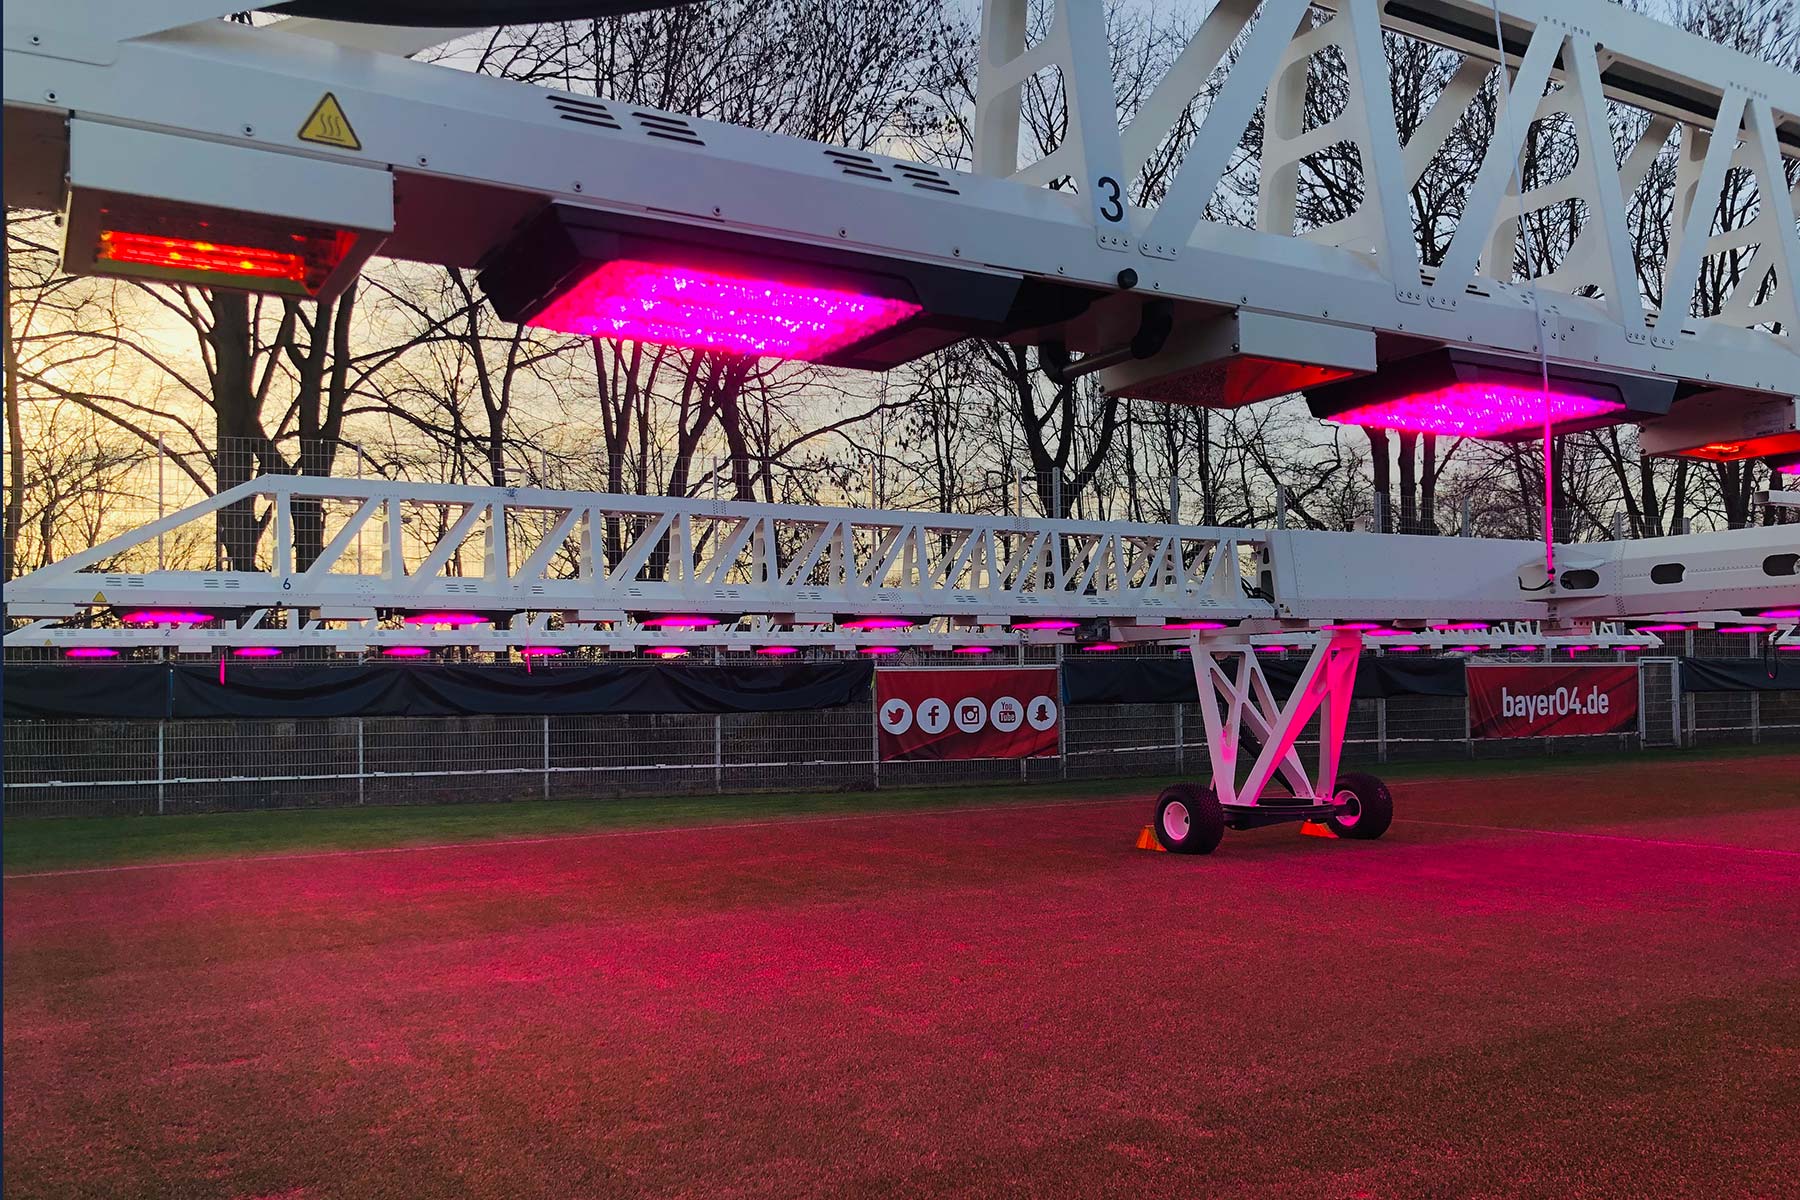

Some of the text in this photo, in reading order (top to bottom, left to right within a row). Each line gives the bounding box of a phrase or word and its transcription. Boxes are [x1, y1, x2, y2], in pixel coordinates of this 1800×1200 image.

[1098, 176, 1124, 222] 3
[283, 578, 291, 590] 6
[1001, 701, 1013, 711] You
[1502, 685, 1609, 723] bayer04.de
[928, 705, 939, 726] f
[999, 712, 1015, 722] Tube
